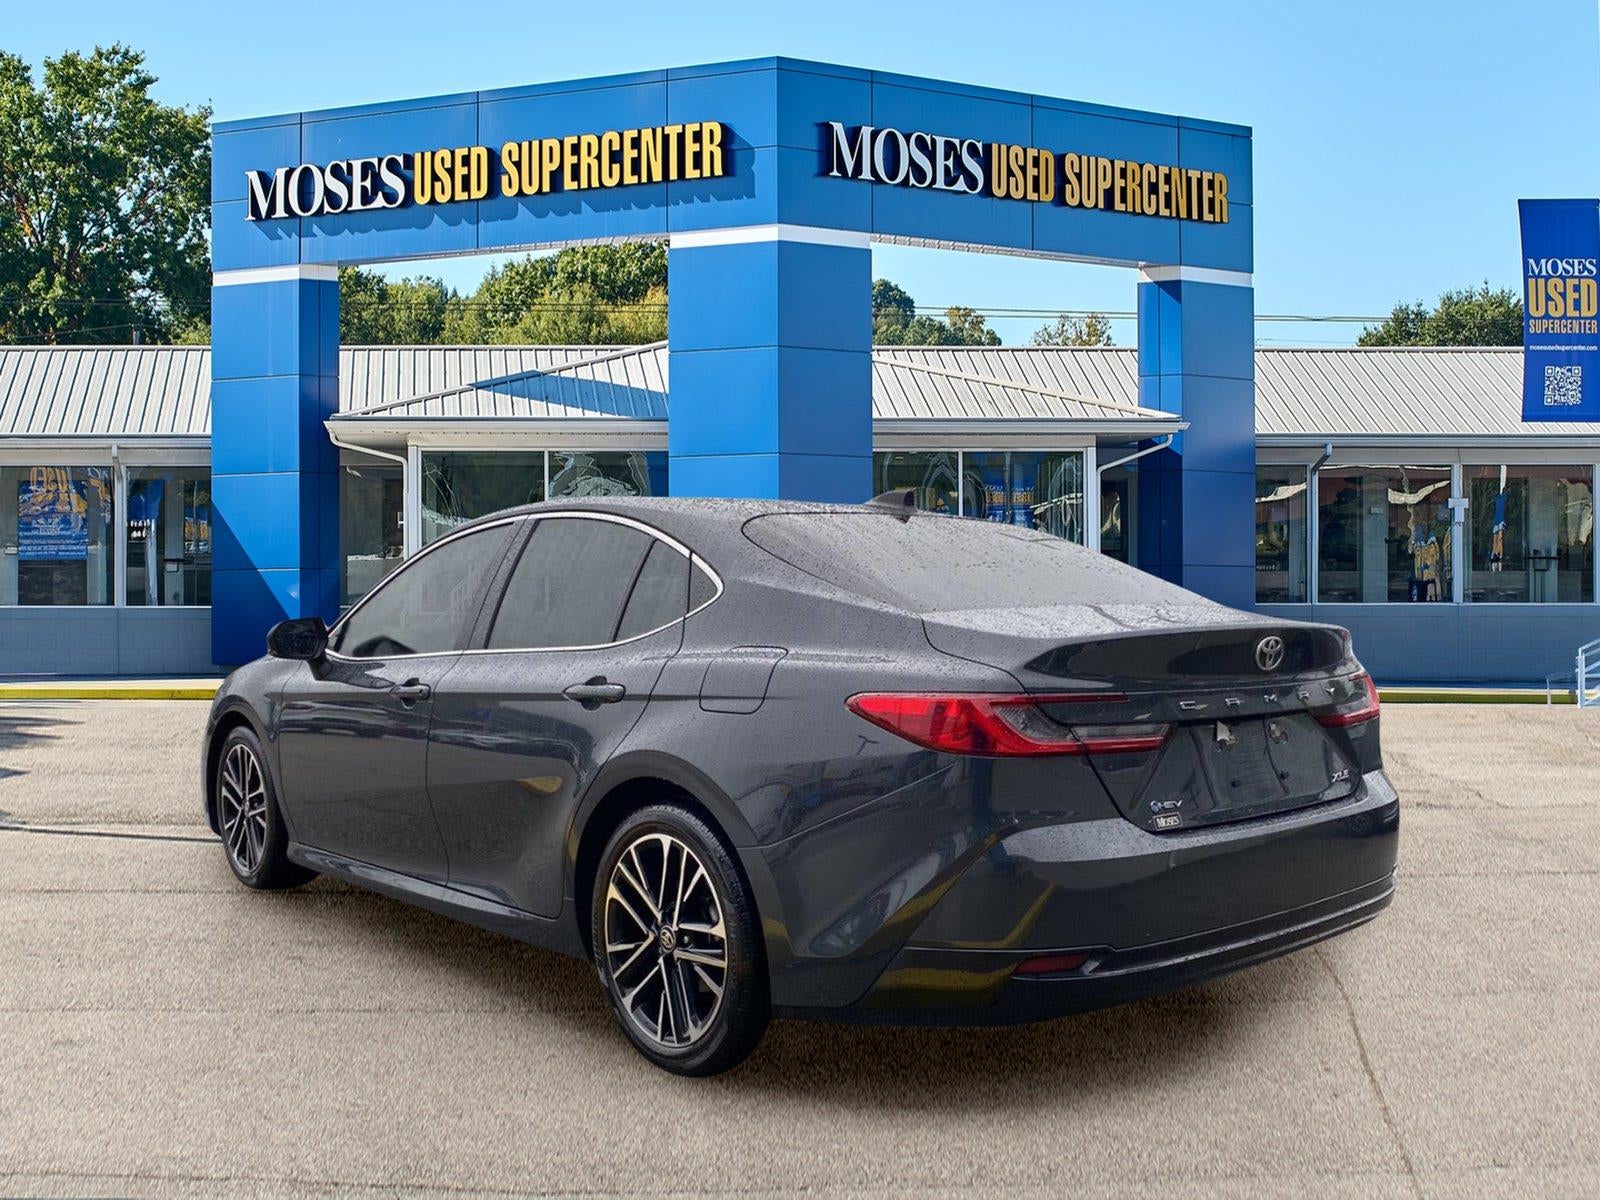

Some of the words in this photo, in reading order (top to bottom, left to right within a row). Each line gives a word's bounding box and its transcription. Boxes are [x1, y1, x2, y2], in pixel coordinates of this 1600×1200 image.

[244, 154, 408, 222] MOSES
[413, 145, 489, 206] USED
[500, 120, 724, 198] SUPERCENTER
[829, 121, 985, 194] MOSES
[991, 142, 1056, 202] USED
[1064, 152, 1230, 224] SUPERCENTER
[1527, 258, 1597, 276] MOSES
[1528, 277, 1598, 318] USED
[1529, 319, 1598, 334] SUPERCENTER
